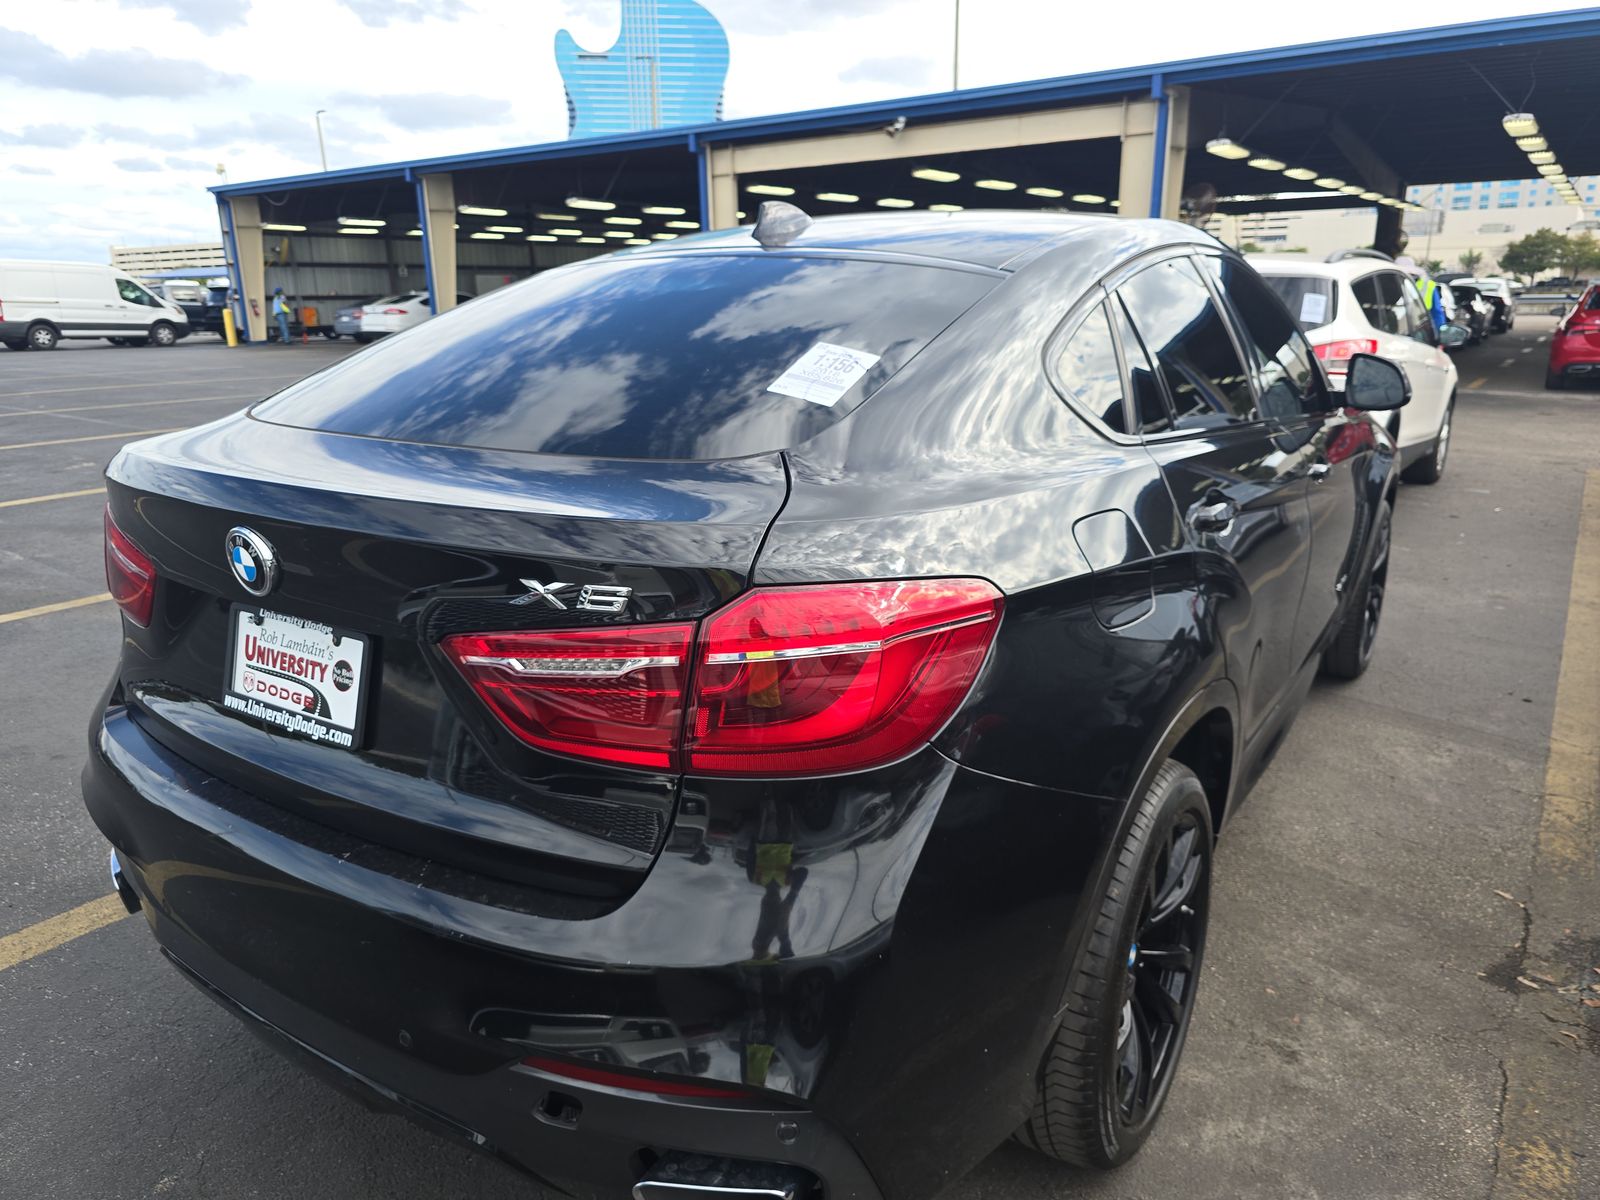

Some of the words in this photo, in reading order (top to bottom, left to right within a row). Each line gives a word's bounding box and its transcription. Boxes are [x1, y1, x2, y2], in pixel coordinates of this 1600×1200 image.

[509, 578, 633, 612] X6
[259, 608, 304, 629] University
[303, 618, 334, 635] Dodge
[245, 634, 329, 683] UNIVERSITY
[259, 628, 278, 645] Rob
[281, 633, 334, 661] Lambdin's
[256, 680, 316, 709] DODGE
[223, 693, 353, 748] www.UniversityDodge.com
